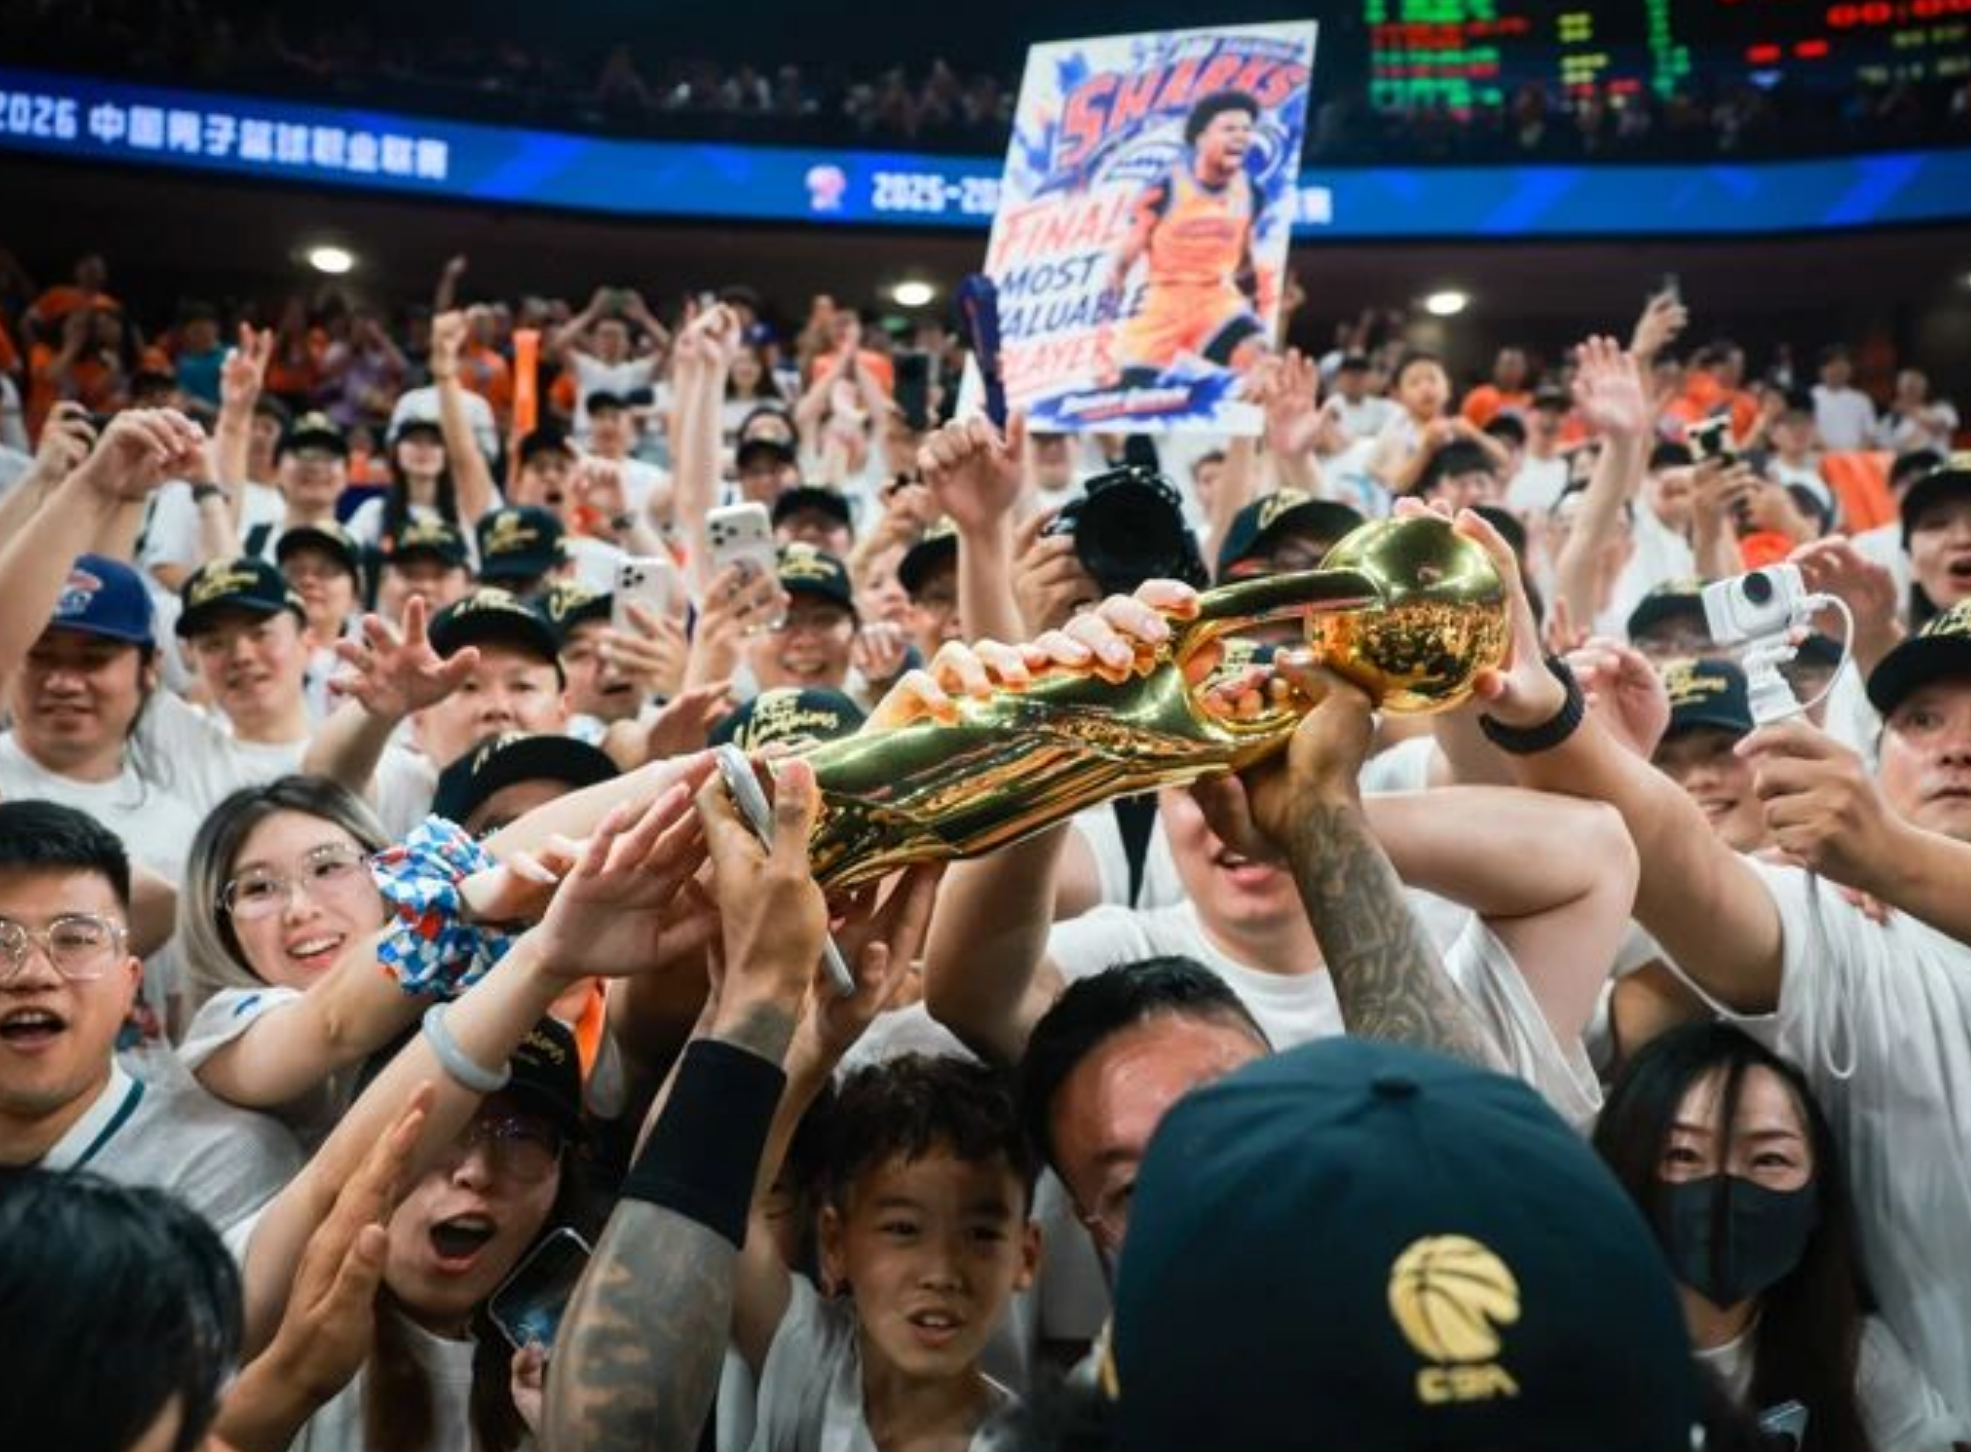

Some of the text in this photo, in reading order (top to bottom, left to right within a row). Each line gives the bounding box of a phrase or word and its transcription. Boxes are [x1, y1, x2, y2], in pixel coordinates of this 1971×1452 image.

[1059, 53, 1309, 165] SHARKS
[872, 171, 1000, 214] 2025-20
[1000, 251, 1104, 300] MOST
